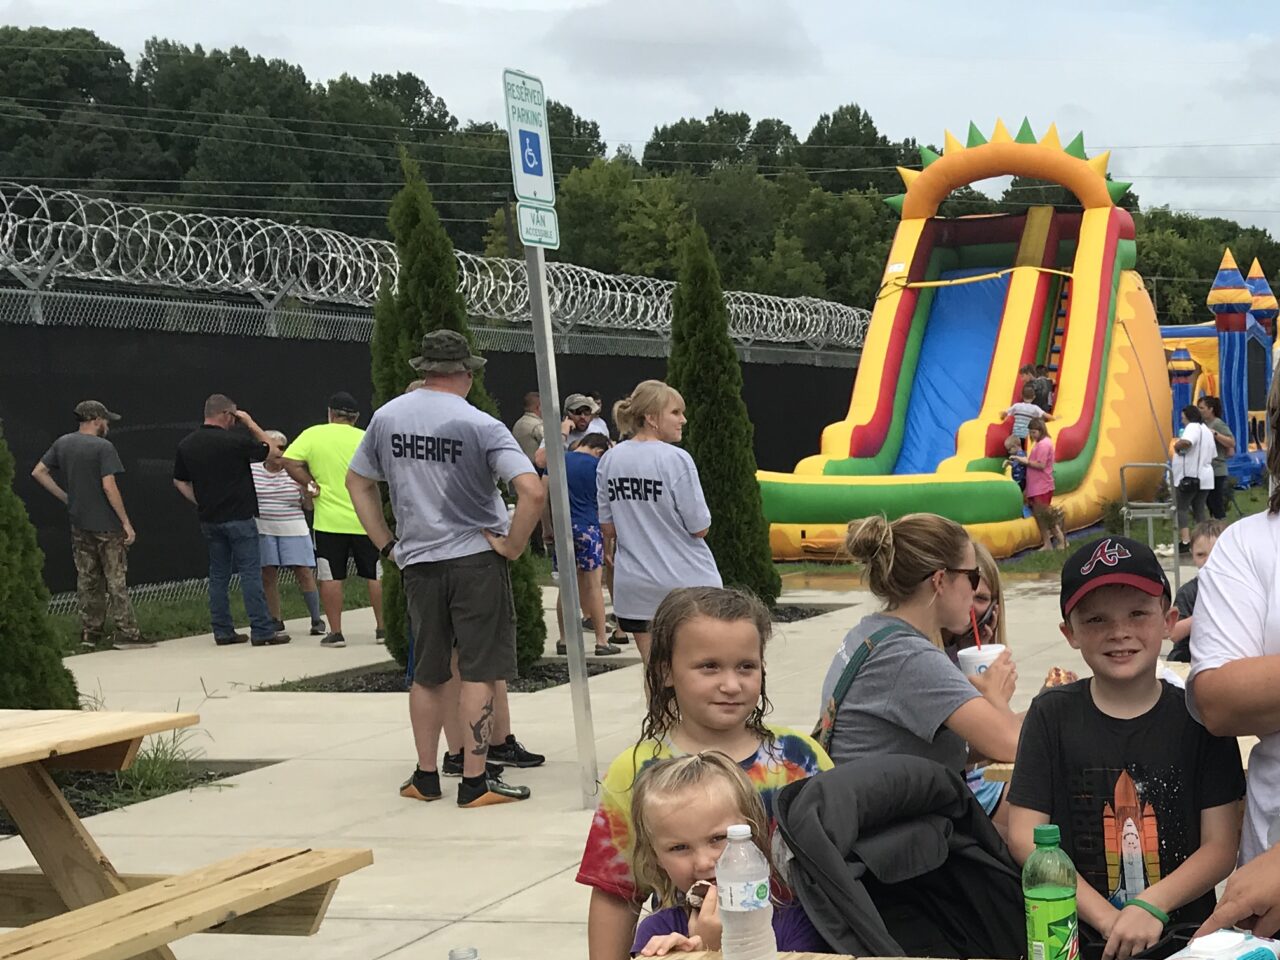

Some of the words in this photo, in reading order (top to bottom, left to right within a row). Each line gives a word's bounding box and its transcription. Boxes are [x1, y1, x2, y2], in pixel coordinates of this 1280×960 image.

[506, 81, 543, 106] RESERVED
[510, 105, 543, 128] PARKING
[530, 212, 547, 227] VAN
[525, 228, 554, 240] ACCESSIBLE
[390, 433, 463, 464] SHERIFF
[607, 477, 663, 502] SHERIFF
